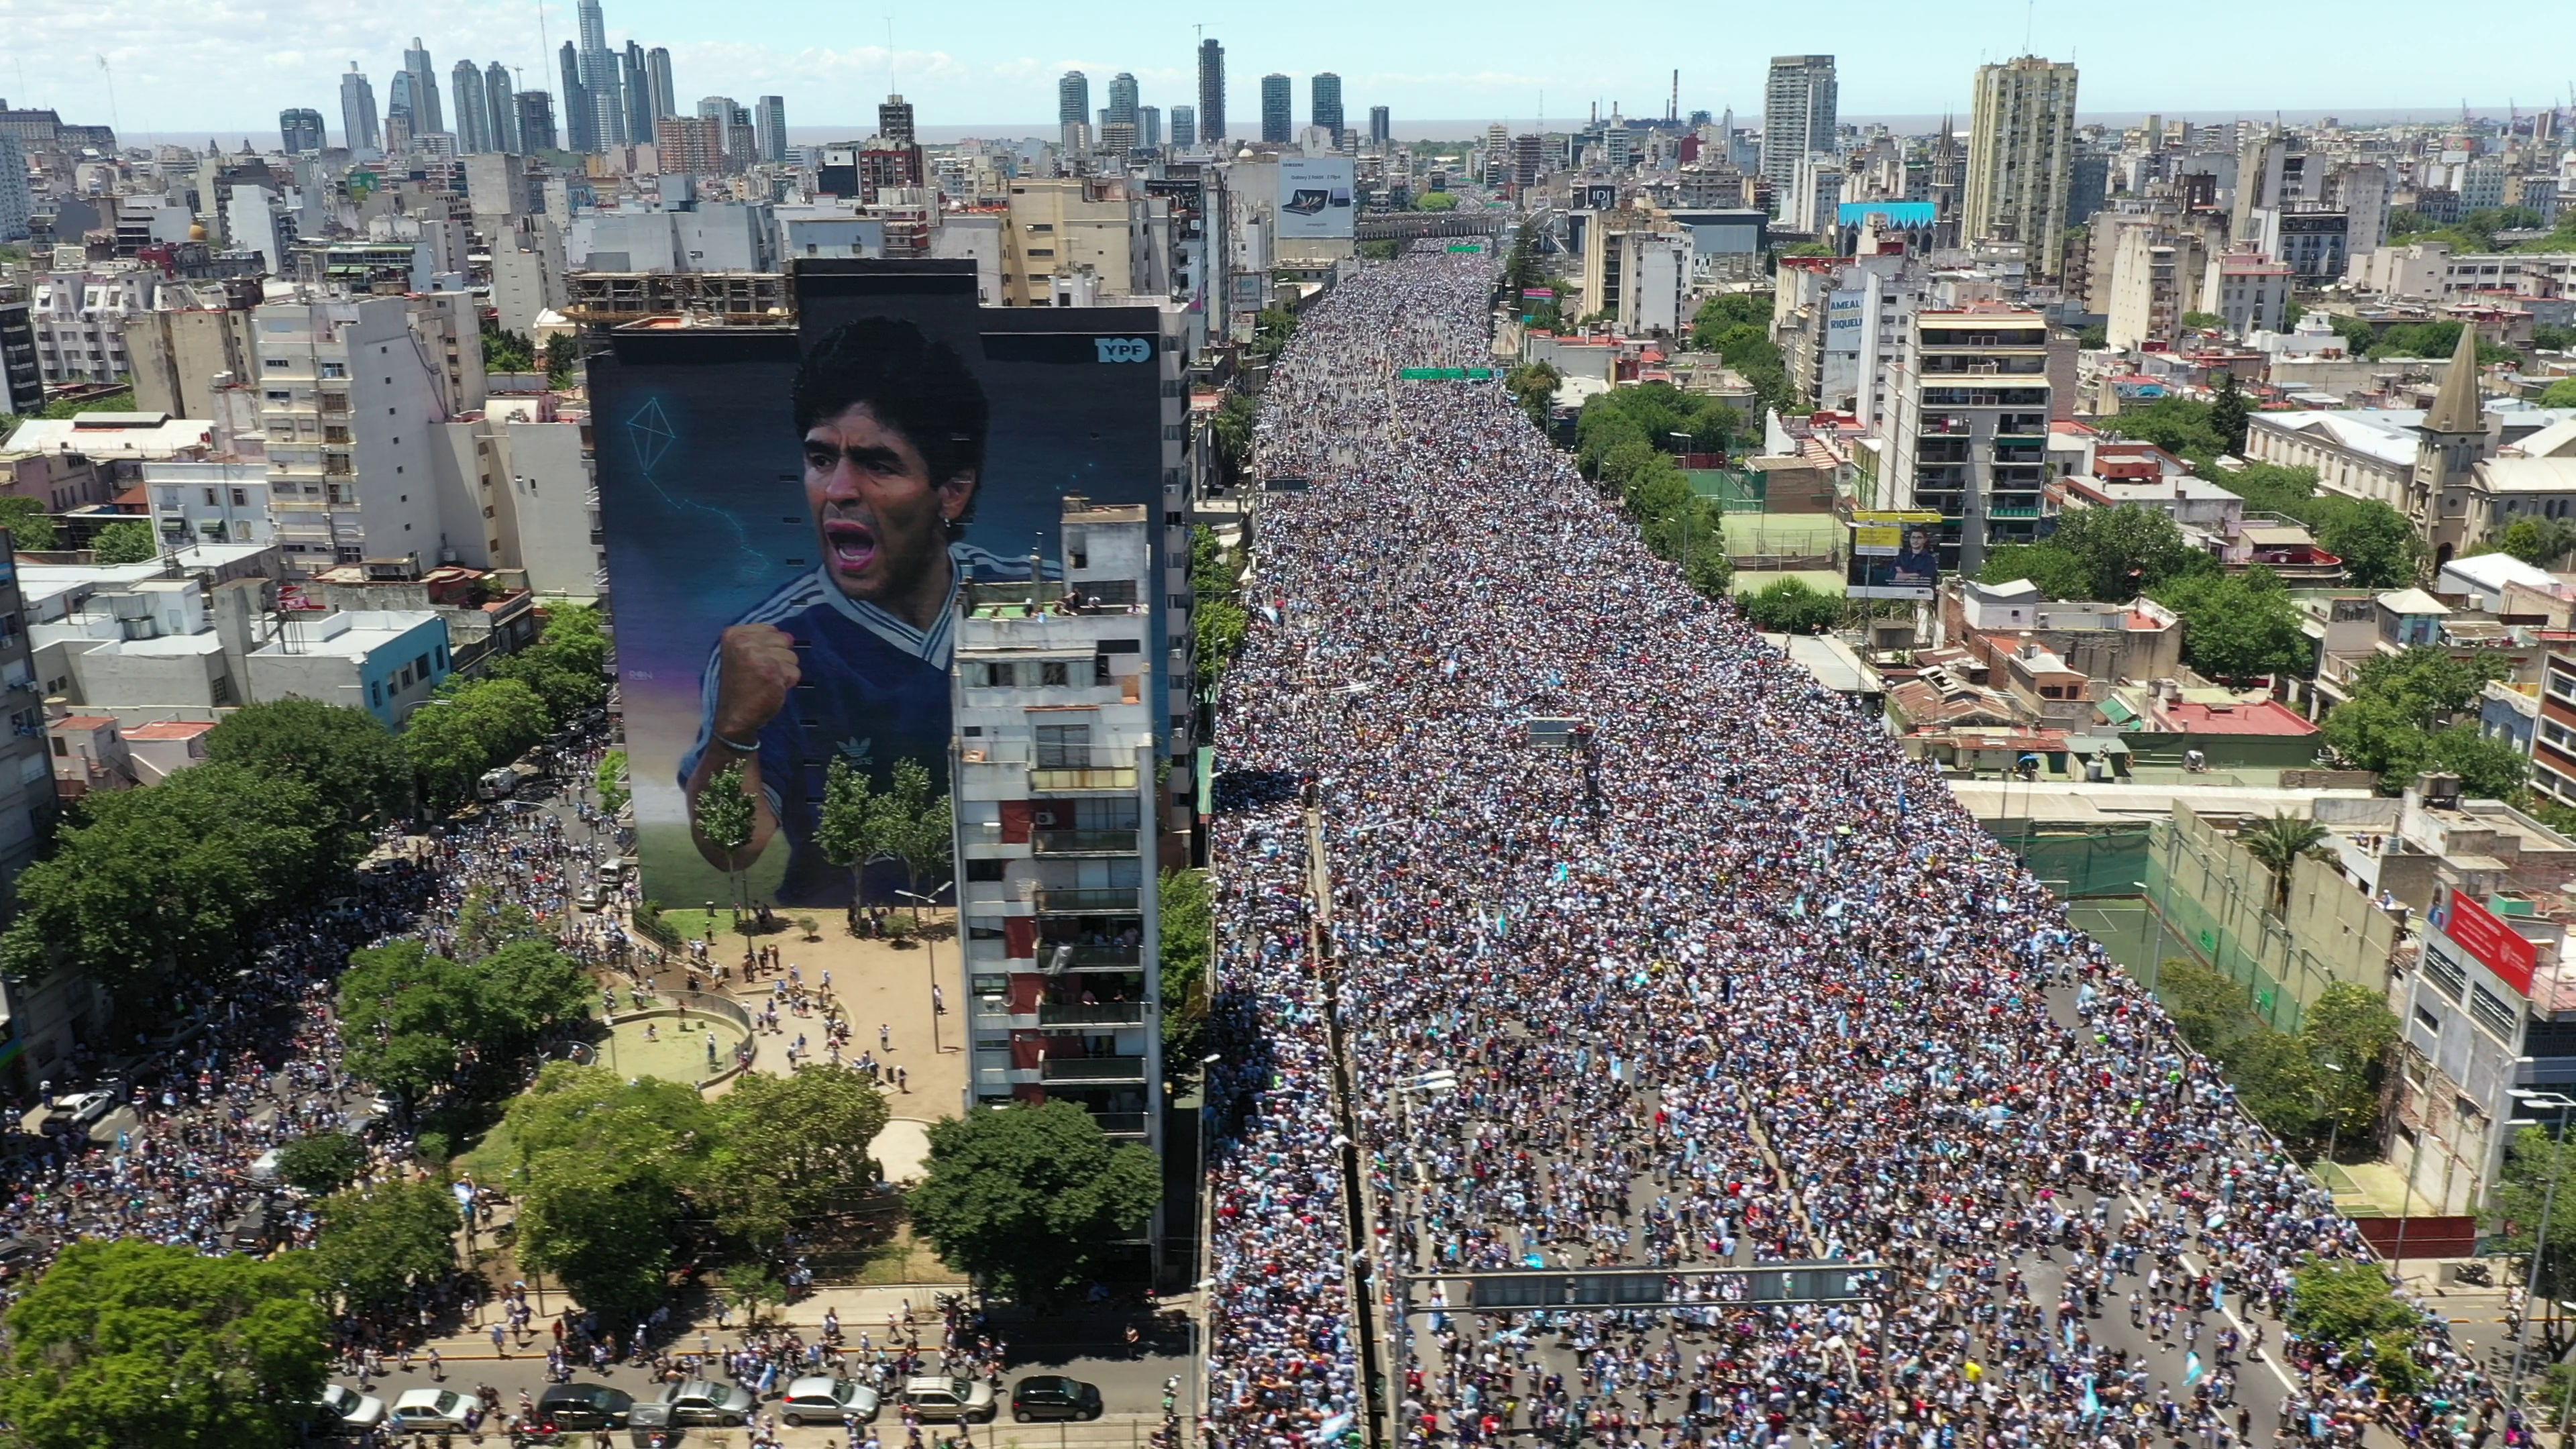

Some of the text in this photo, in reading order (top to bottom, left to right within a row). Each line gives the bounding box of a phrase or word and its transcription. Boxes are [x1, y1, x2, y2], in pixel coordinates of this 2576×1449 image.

[1593, 190, 1611, 201] IDI
[1831, 299, 1860, 310] AMEAL
[1104, 345, 1142, 356] YPF
